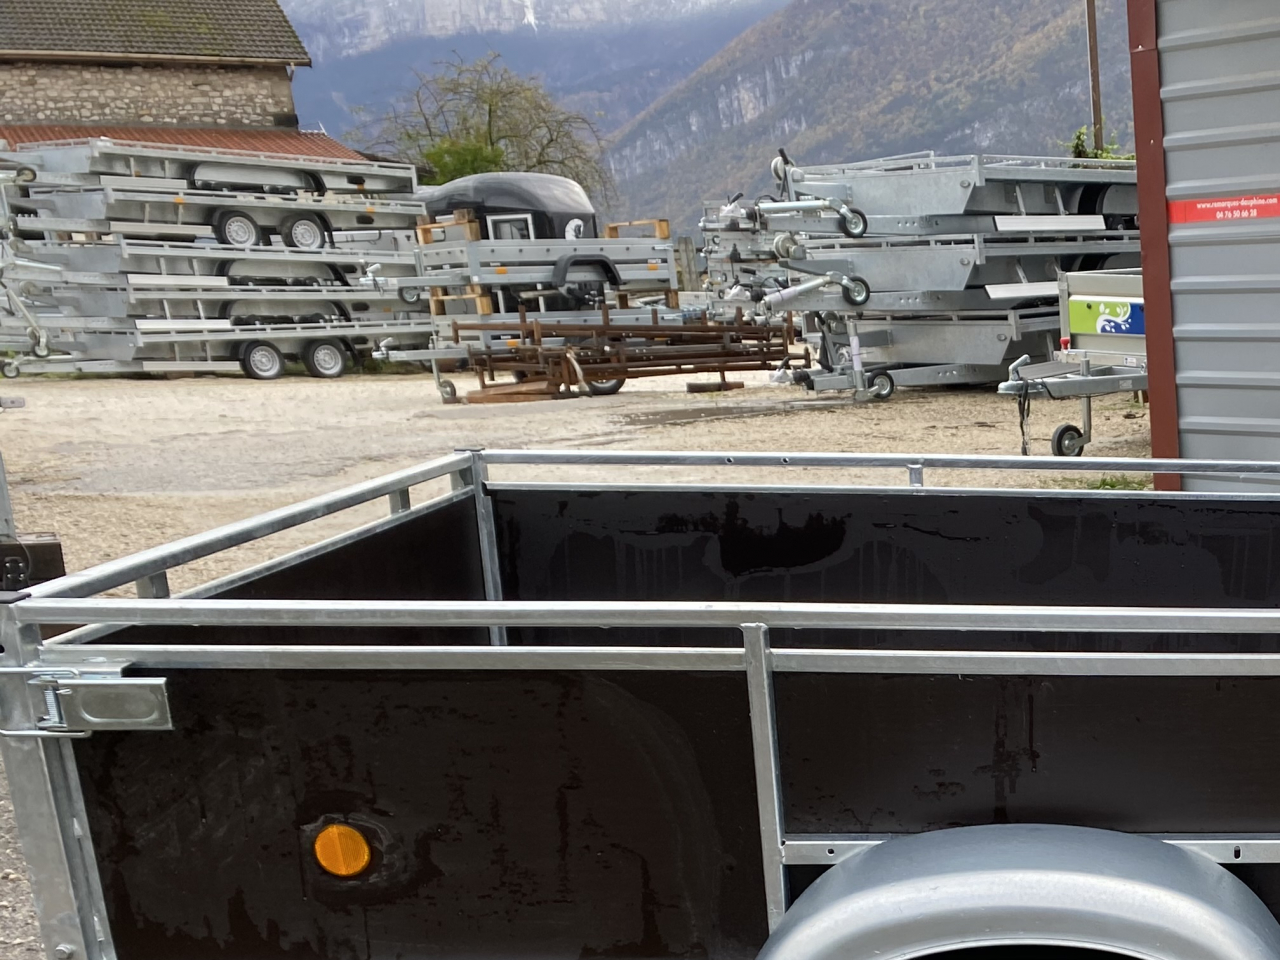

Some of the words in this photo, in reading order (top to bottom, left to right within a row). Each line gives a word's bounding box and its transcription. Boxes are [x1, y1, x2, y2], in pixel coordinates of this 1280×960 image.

[1216, 211, 1224, 219] 04
[1224, 210, 1232, 219] 76
[1233, 210, 1241, 218] 50
[1241, 209, 1249, 218] 66
[1250, 209, 1258, 217] 28
